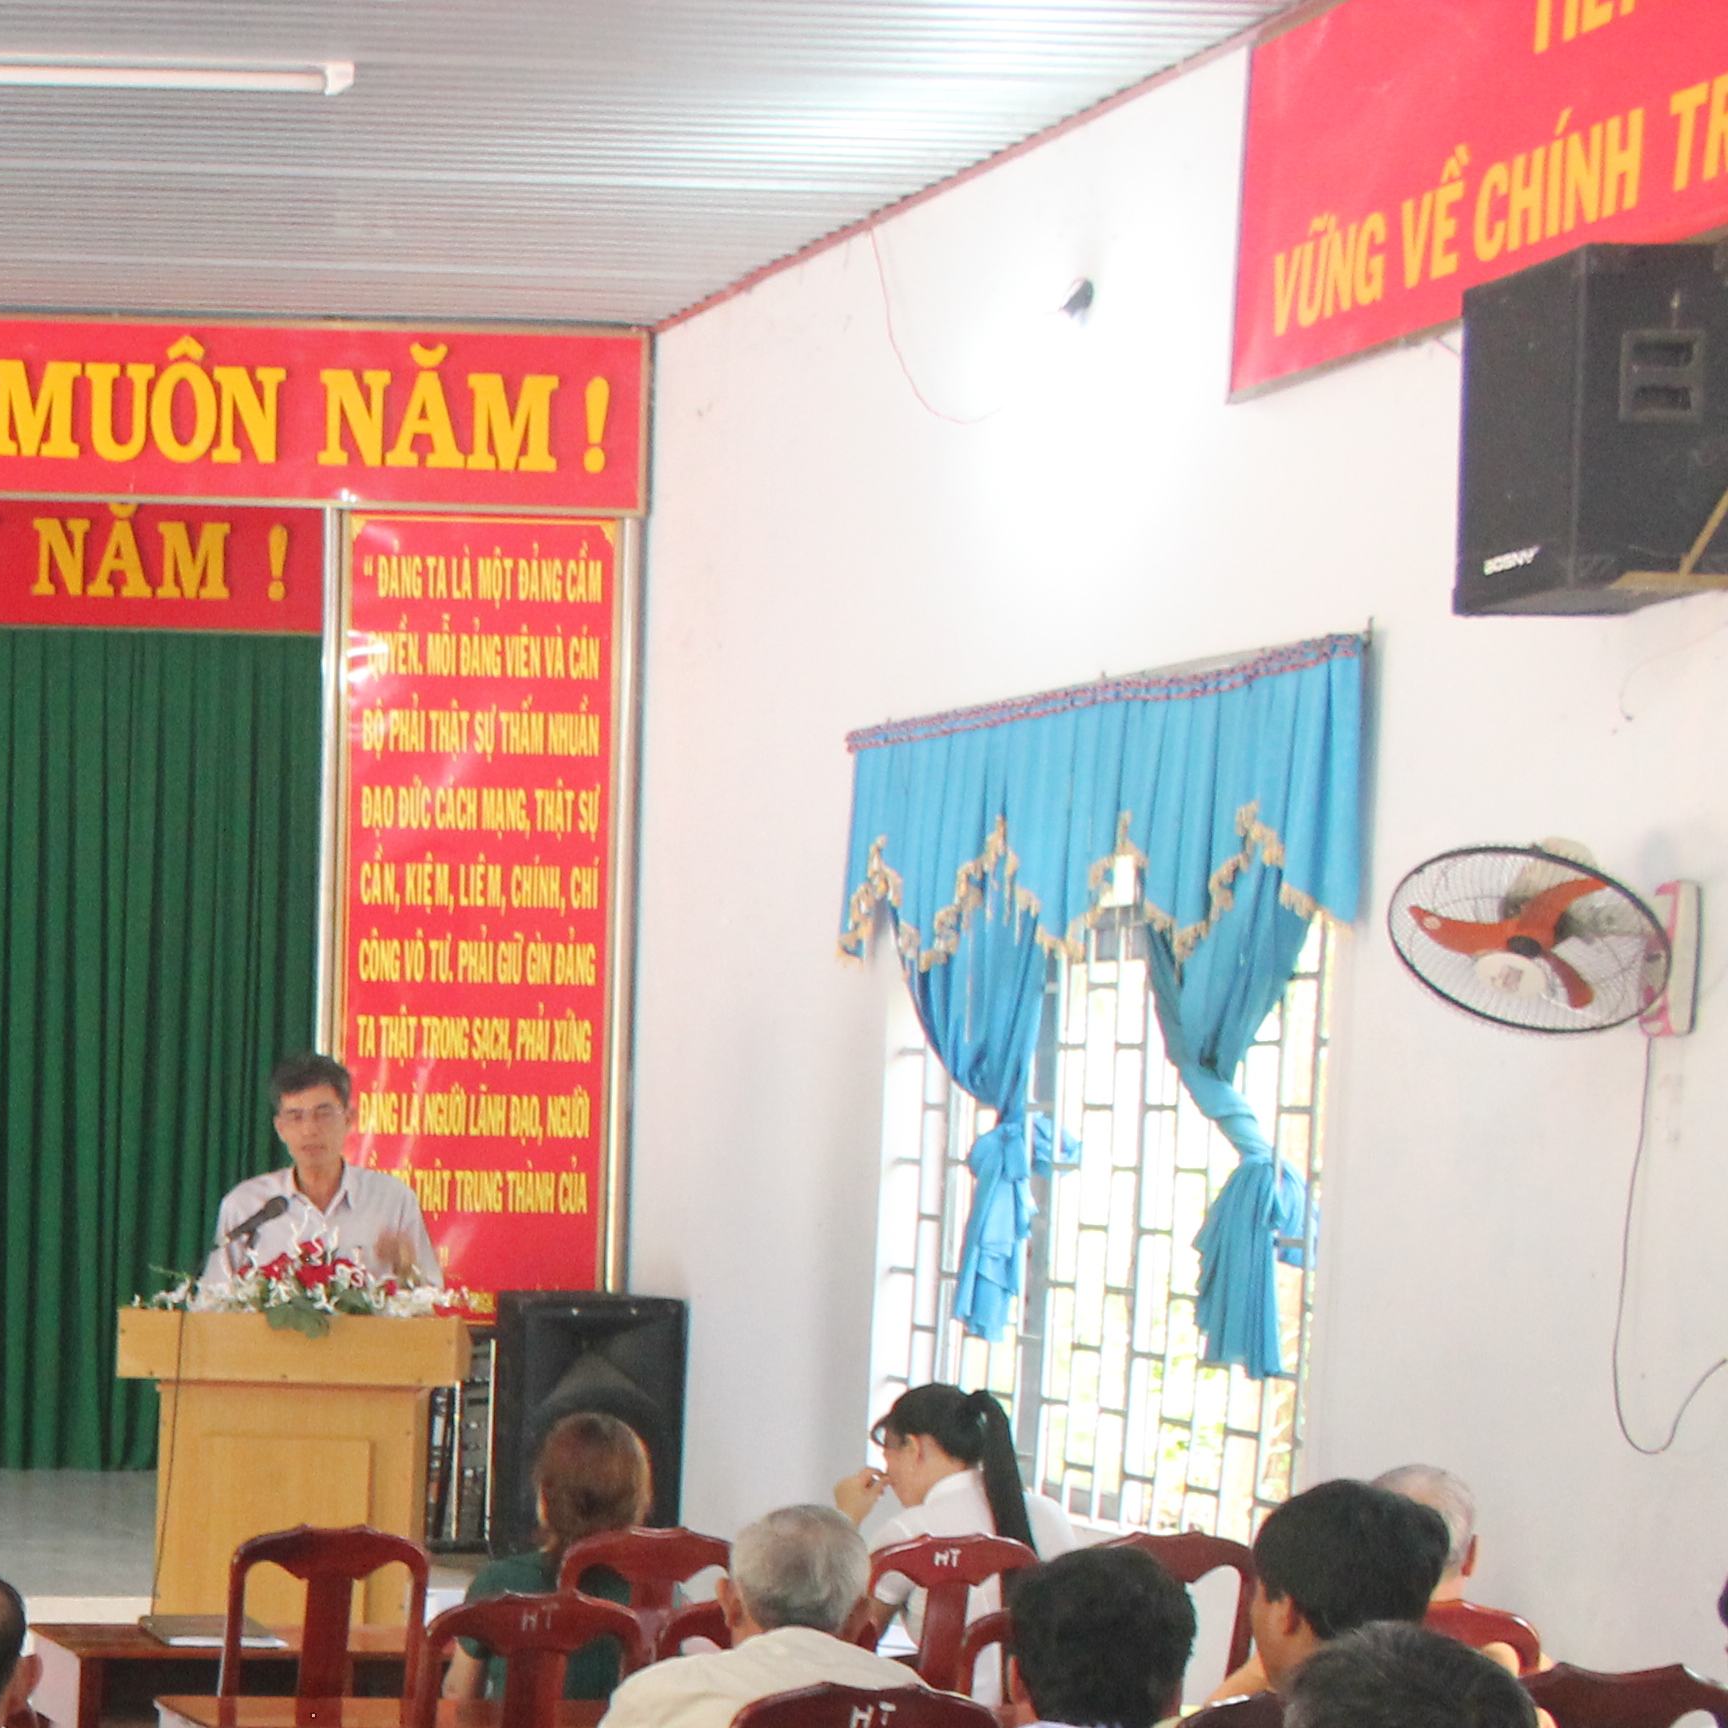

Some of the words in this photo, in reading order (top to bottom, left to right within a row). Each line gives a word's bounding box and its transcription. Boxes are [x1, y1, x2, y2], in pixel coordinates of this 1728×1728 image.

[1402, 144, 1470, 288] VỀ
[1474, 108, 1644, 261] CHÍNH
[318, 343, 559, 472] NĂM
[33, 502, 230, 599] NĂM
[377, 540, 425, 599] ĐẢNG
[425, 555, 449, 598] TA
[451, 546, 473, 599] LÀ
[478, 547, 516, 607] MỘT
[518, 543, 565, 602] ĐẢNG
[564, 542, 603, 602] CẦM
[458, 618, 503, 677] ĐẢNG
[503, 625, 543, 678] VIÊN
[543, 626, 566, 678] VÀ
[568, 626, 600, 679] CÁN
[362, 699, 386, 759] BỘ
[389, 694, 427, 752] PHẢI
[427, 700, 472, 753] THẬT
[474, 704, 498, 762] SỰ
[499, 696, 546, 755] THẤM
[546, 696, 600, 756] NHUẦN
[361, 785, 396, 835] ĐẠO
[396, 776, 433, 829] ĐỨC
[434, 778, 480, 830] CÁCH
[481, 788, 532, 838] MẠNG,
[534, 779, 576, 839] THẬT
[578, 784, 601, 841] SỰ
[360, 845, 402, 911] CẦN,
[405, 852, 455, 912] KIỆM,
[458, 853, 507, 914] LIÊM,
[510, 858, 567, 915] CHÍNH,
[570, 858, 599, 909] CHÍ
[359, 928, 403, 982] CÔNG
[402, 929, 427, 982] VÔ
[458, 925, 495, 983] PHẢI
[495, 932, 524, 984] GIỮ
[524, 933, 553, 984] GÌN
[553, 927, 597, 986] ĐẢNG
[356, 1014, 377, 1057] TA
[378, 1006, 419, 1065] THẬT
[419, 1016, 471, 1059] TRONG
[470, 1017, 514, 1067] SẠCH,
[516, 1003, 551, 1060] PHẢI
[400, 1082, 421, 1141] LÀ
[453, 1169, 505, 1213] TRUNG
[505, 1162, 556, 1213] THÀNH
[557, 1156, 588, 1214] CỦA
[934, 1548, 961, 1567] HT
